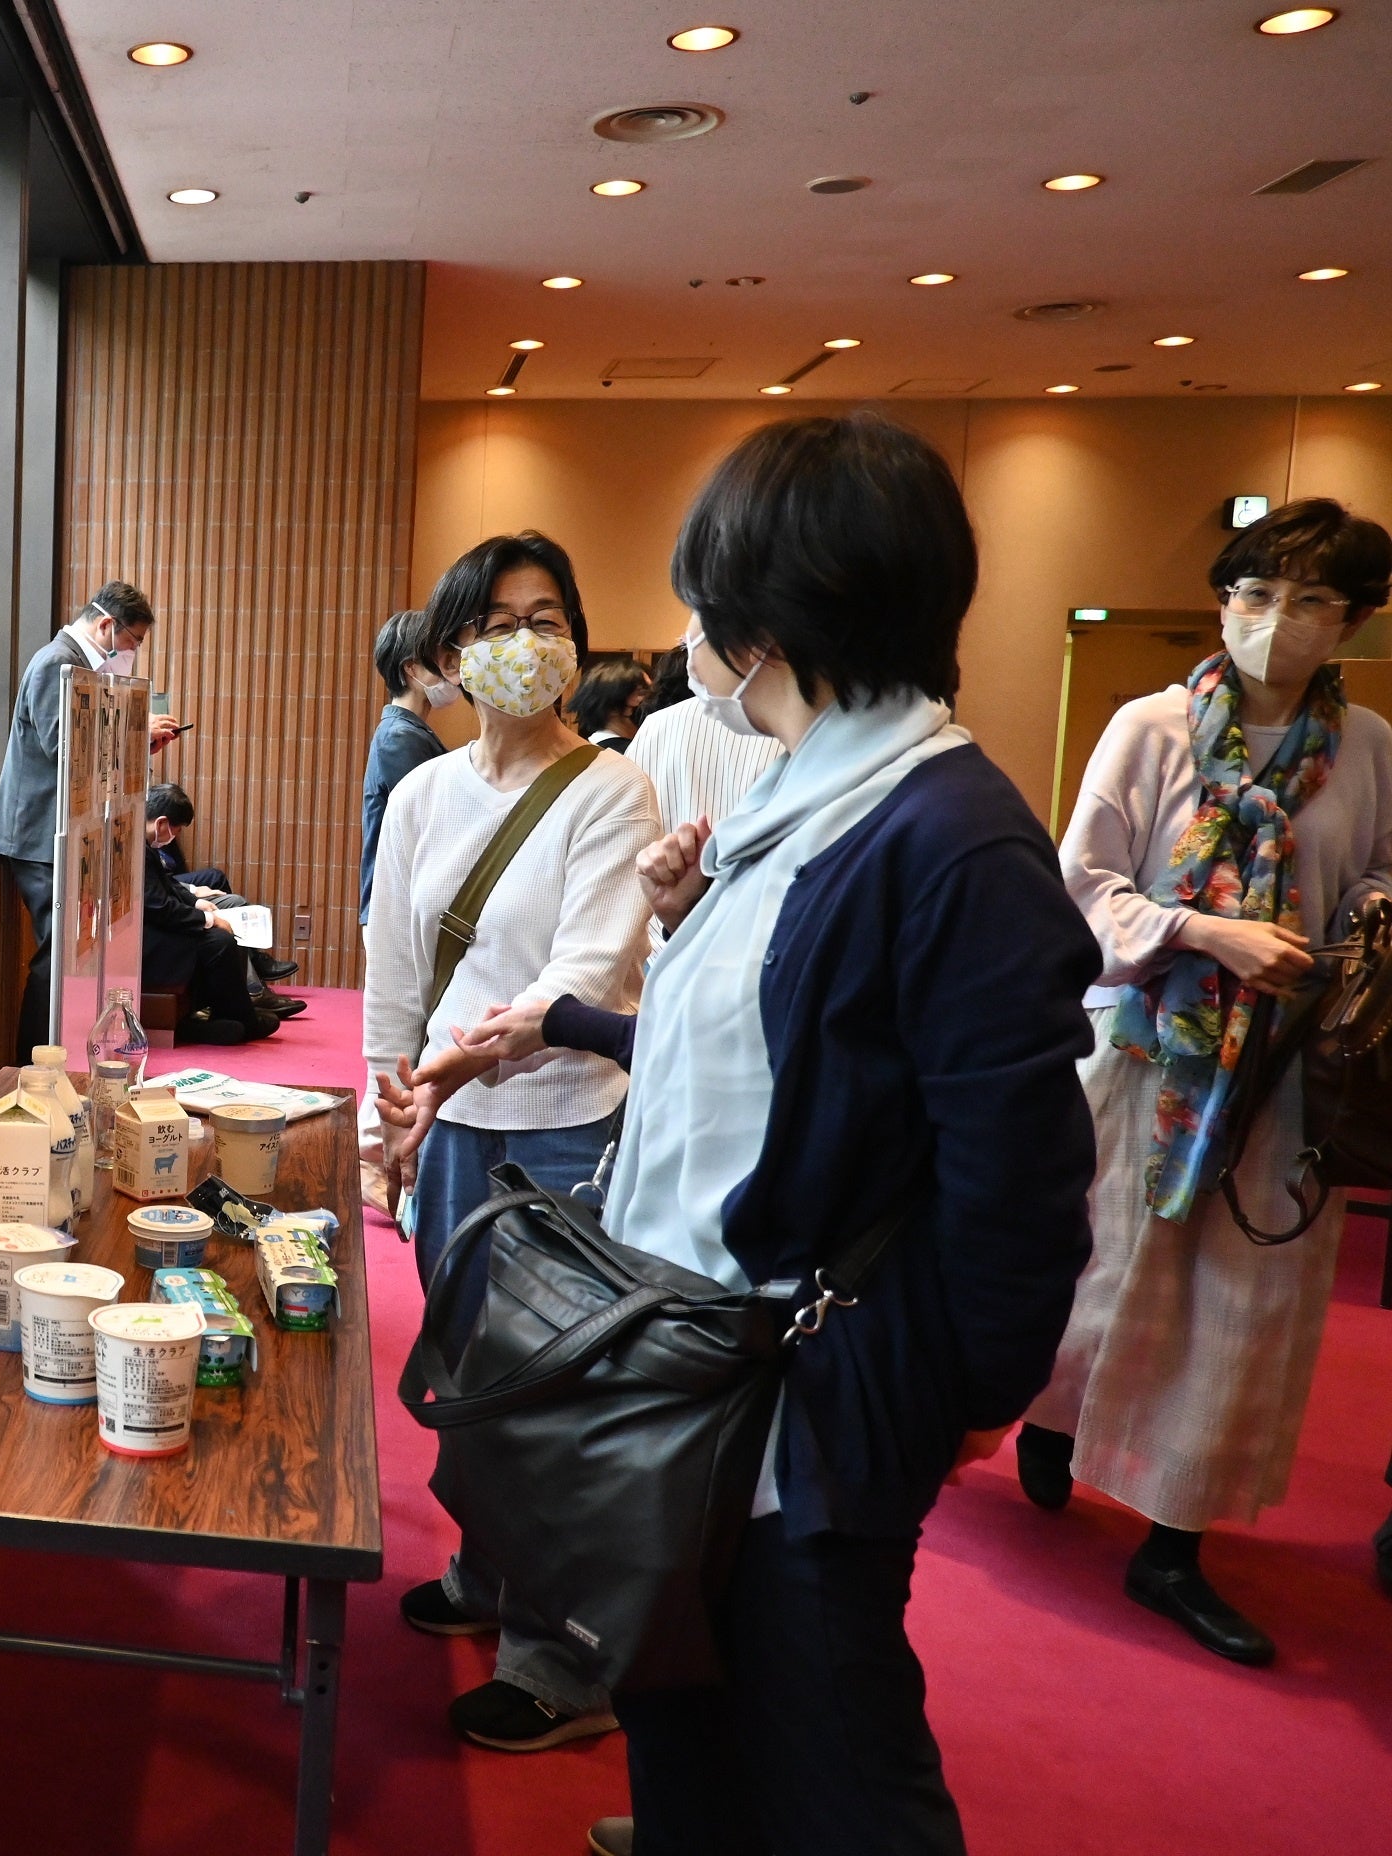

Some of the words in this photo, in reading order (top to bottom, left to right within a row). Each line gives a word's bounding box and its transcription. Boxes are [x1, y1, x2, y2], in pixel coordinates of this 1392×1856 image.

[157, 1124, 175, 1134] 飲む
[148, 1132, 183, 1144] ヨーグルト
[132, 1346, 186, 1358] 生活クラブ
